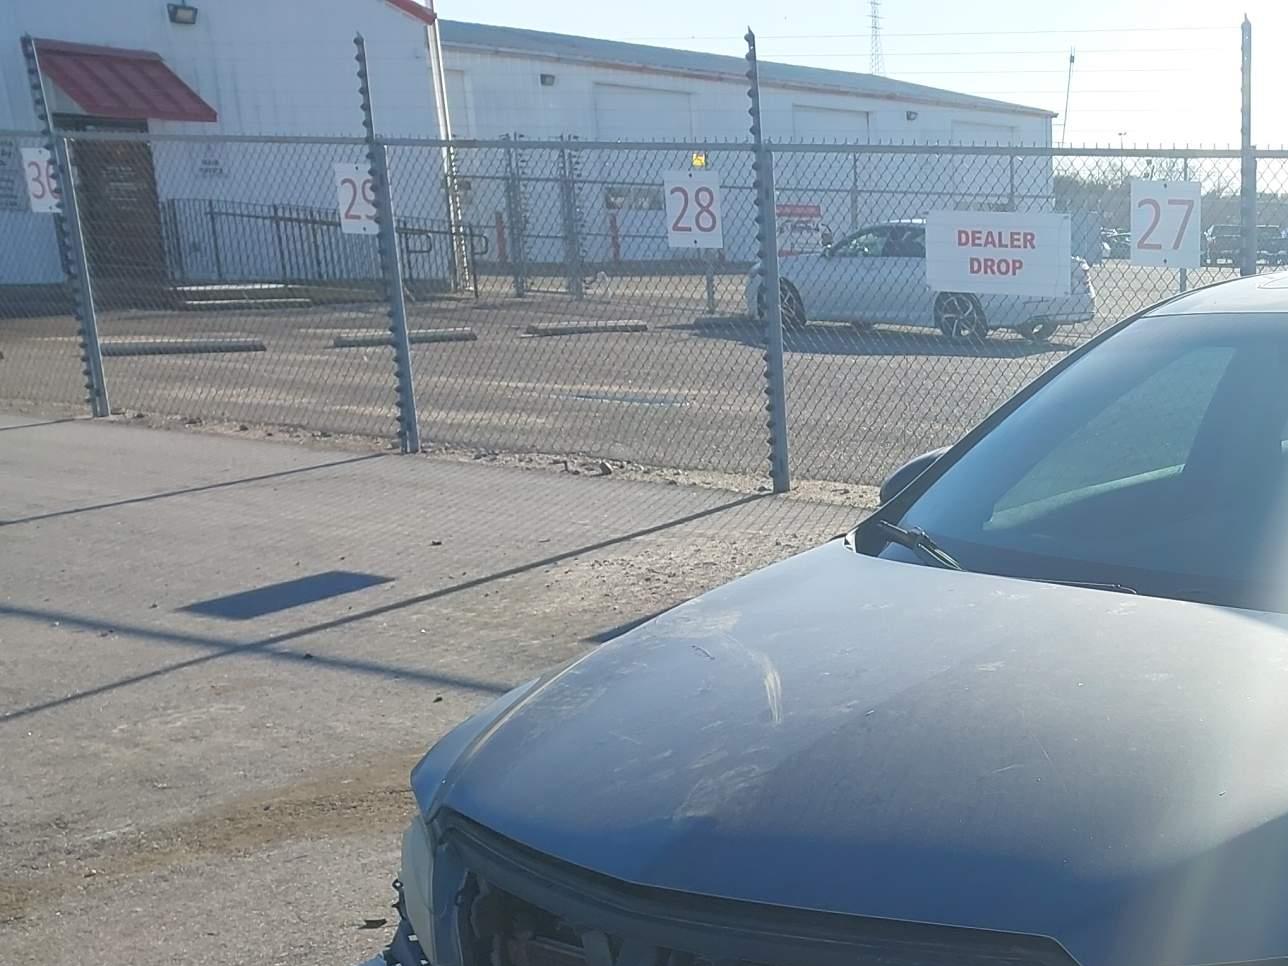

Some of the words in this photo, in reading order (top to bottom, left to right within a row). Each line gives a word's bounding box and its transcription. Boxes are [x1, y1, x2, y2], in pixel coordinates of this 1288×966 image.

[670, 186, 717, 232] 28
[1136, 197, 1194, 250] 27
[957, 229, 1036, 249] DEALER
[969, 257, 1024, 276] DROP
